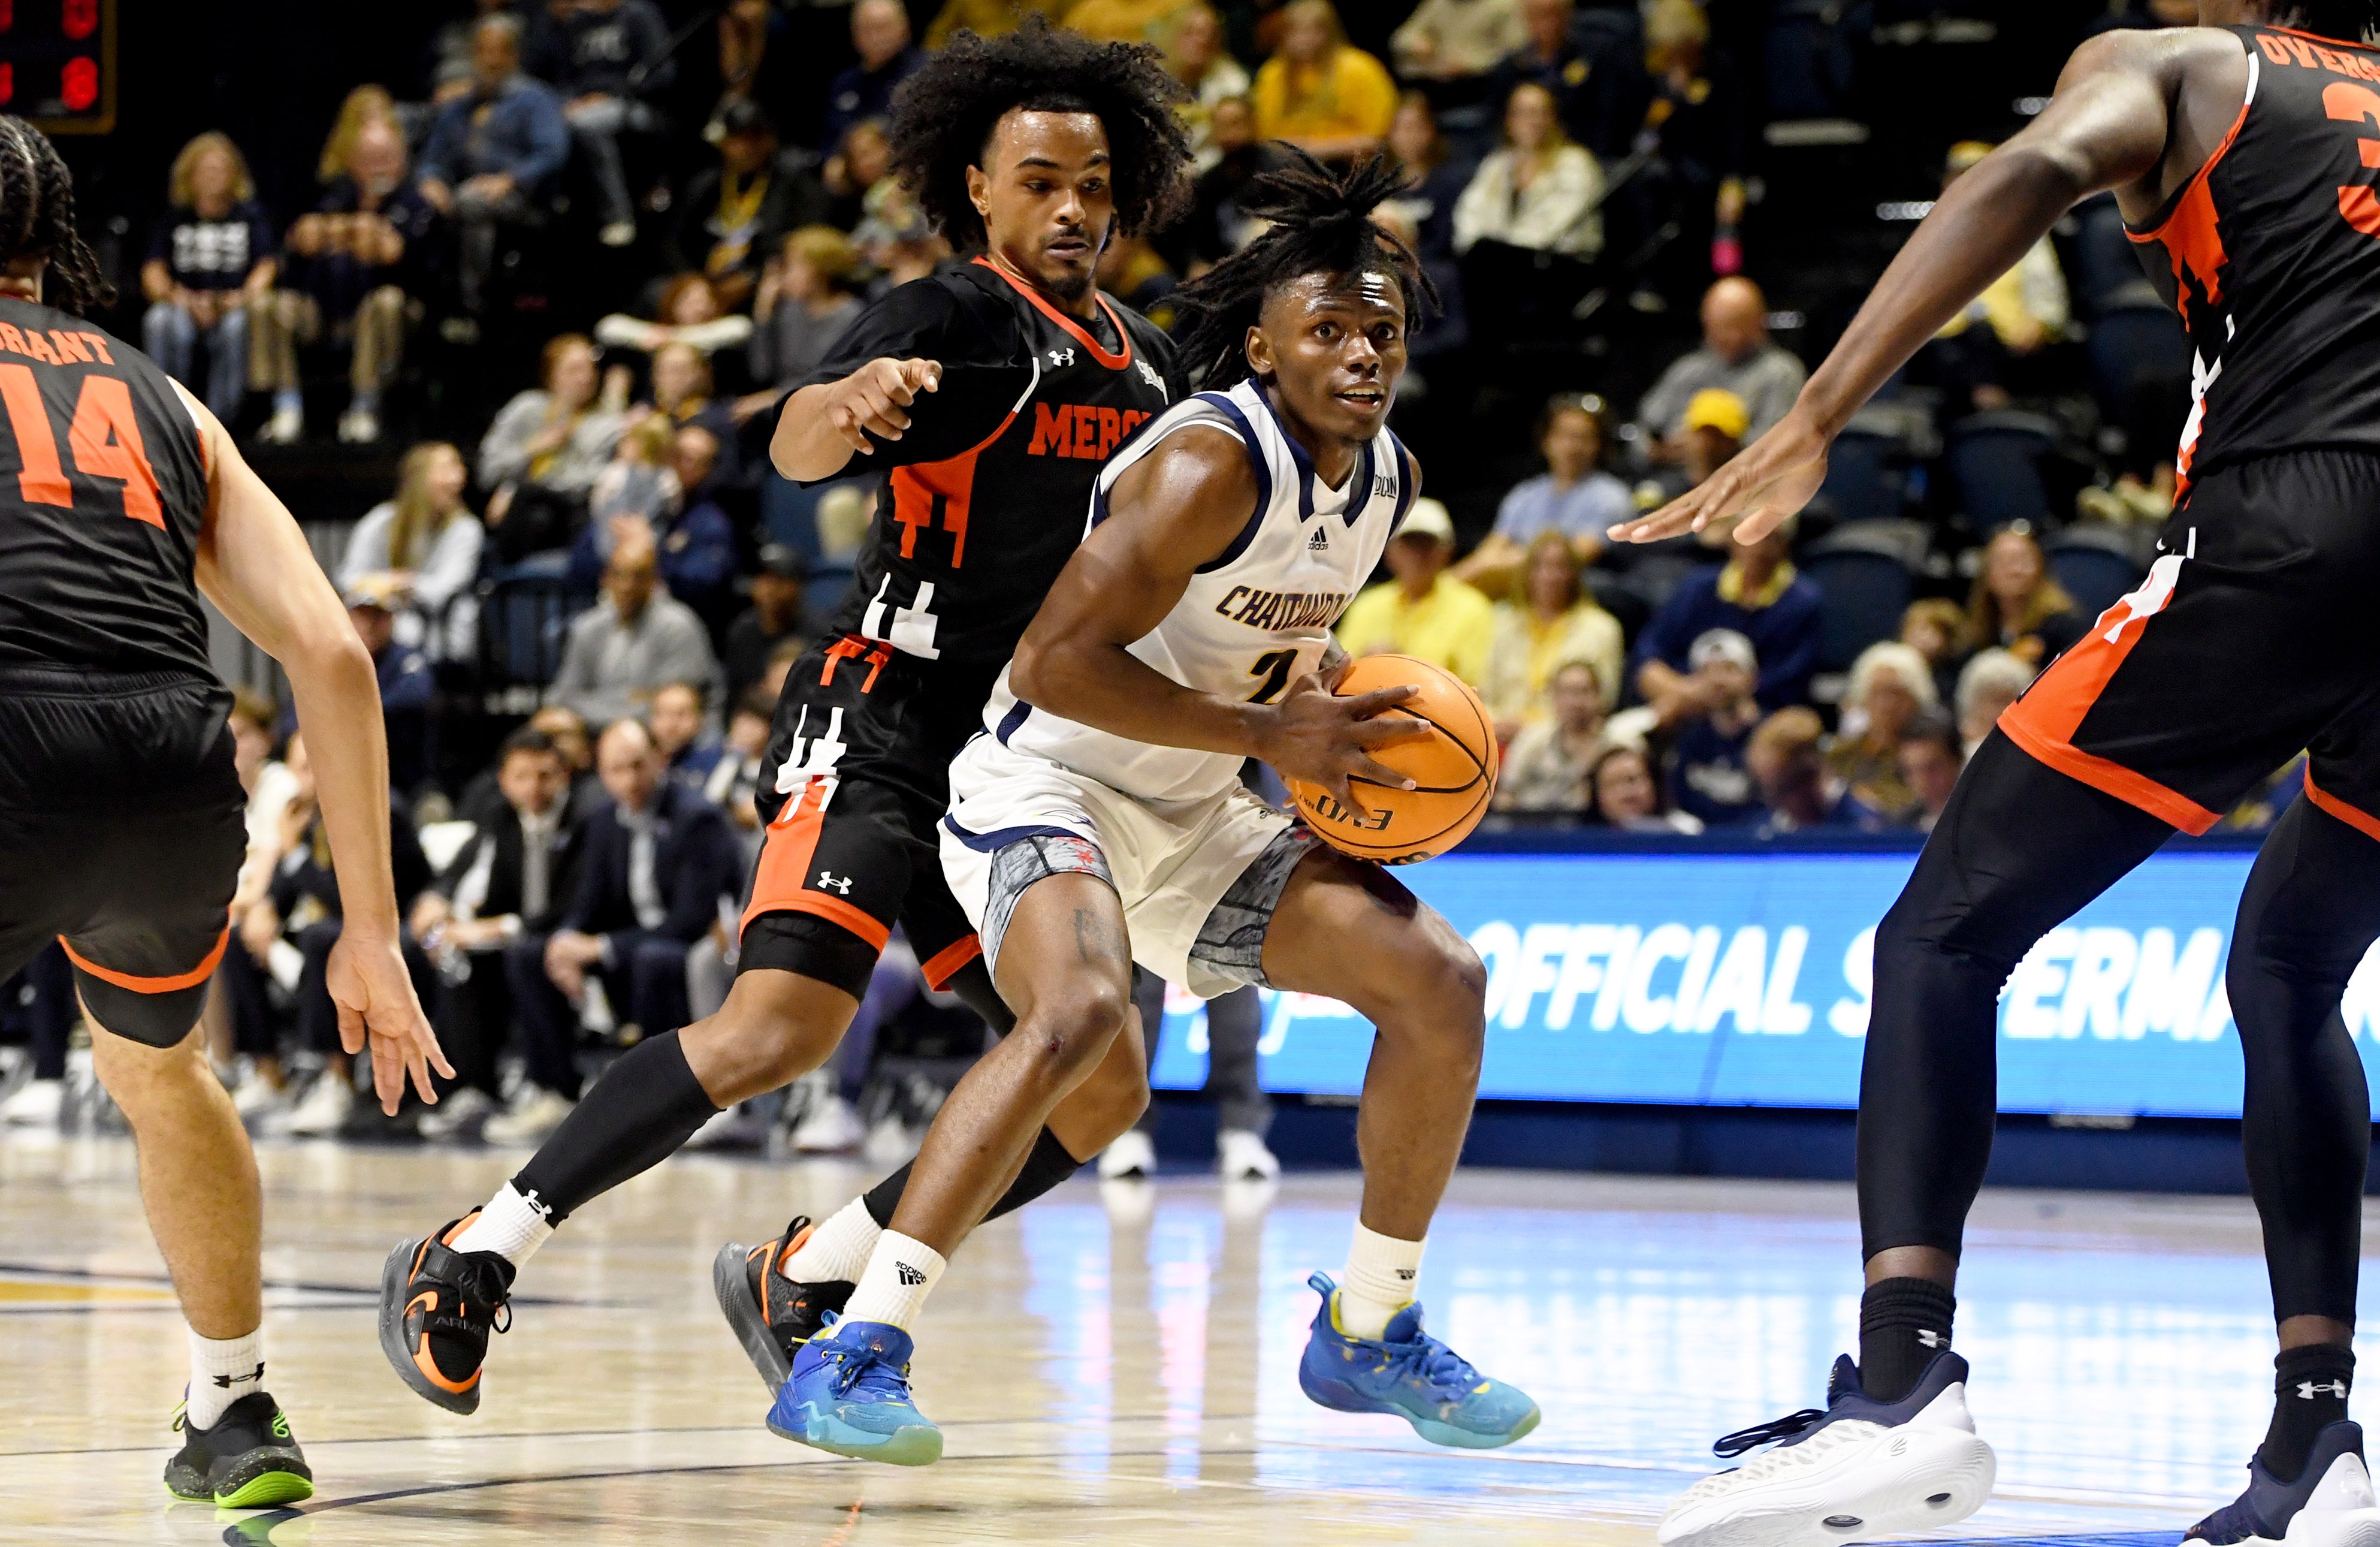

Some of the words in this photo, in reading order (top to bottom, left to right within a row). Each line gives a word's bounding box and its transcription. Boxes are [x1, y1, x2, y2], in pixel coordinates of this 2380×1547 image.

[0, 322, 114, 365] RANT
[0, 363, 166, 531] 14
[1028, 402, 1152, 460] MERC
[1467, 921, 1813, 1034] OFFICIAL
[895, 1261, 926, 1283] adidas
